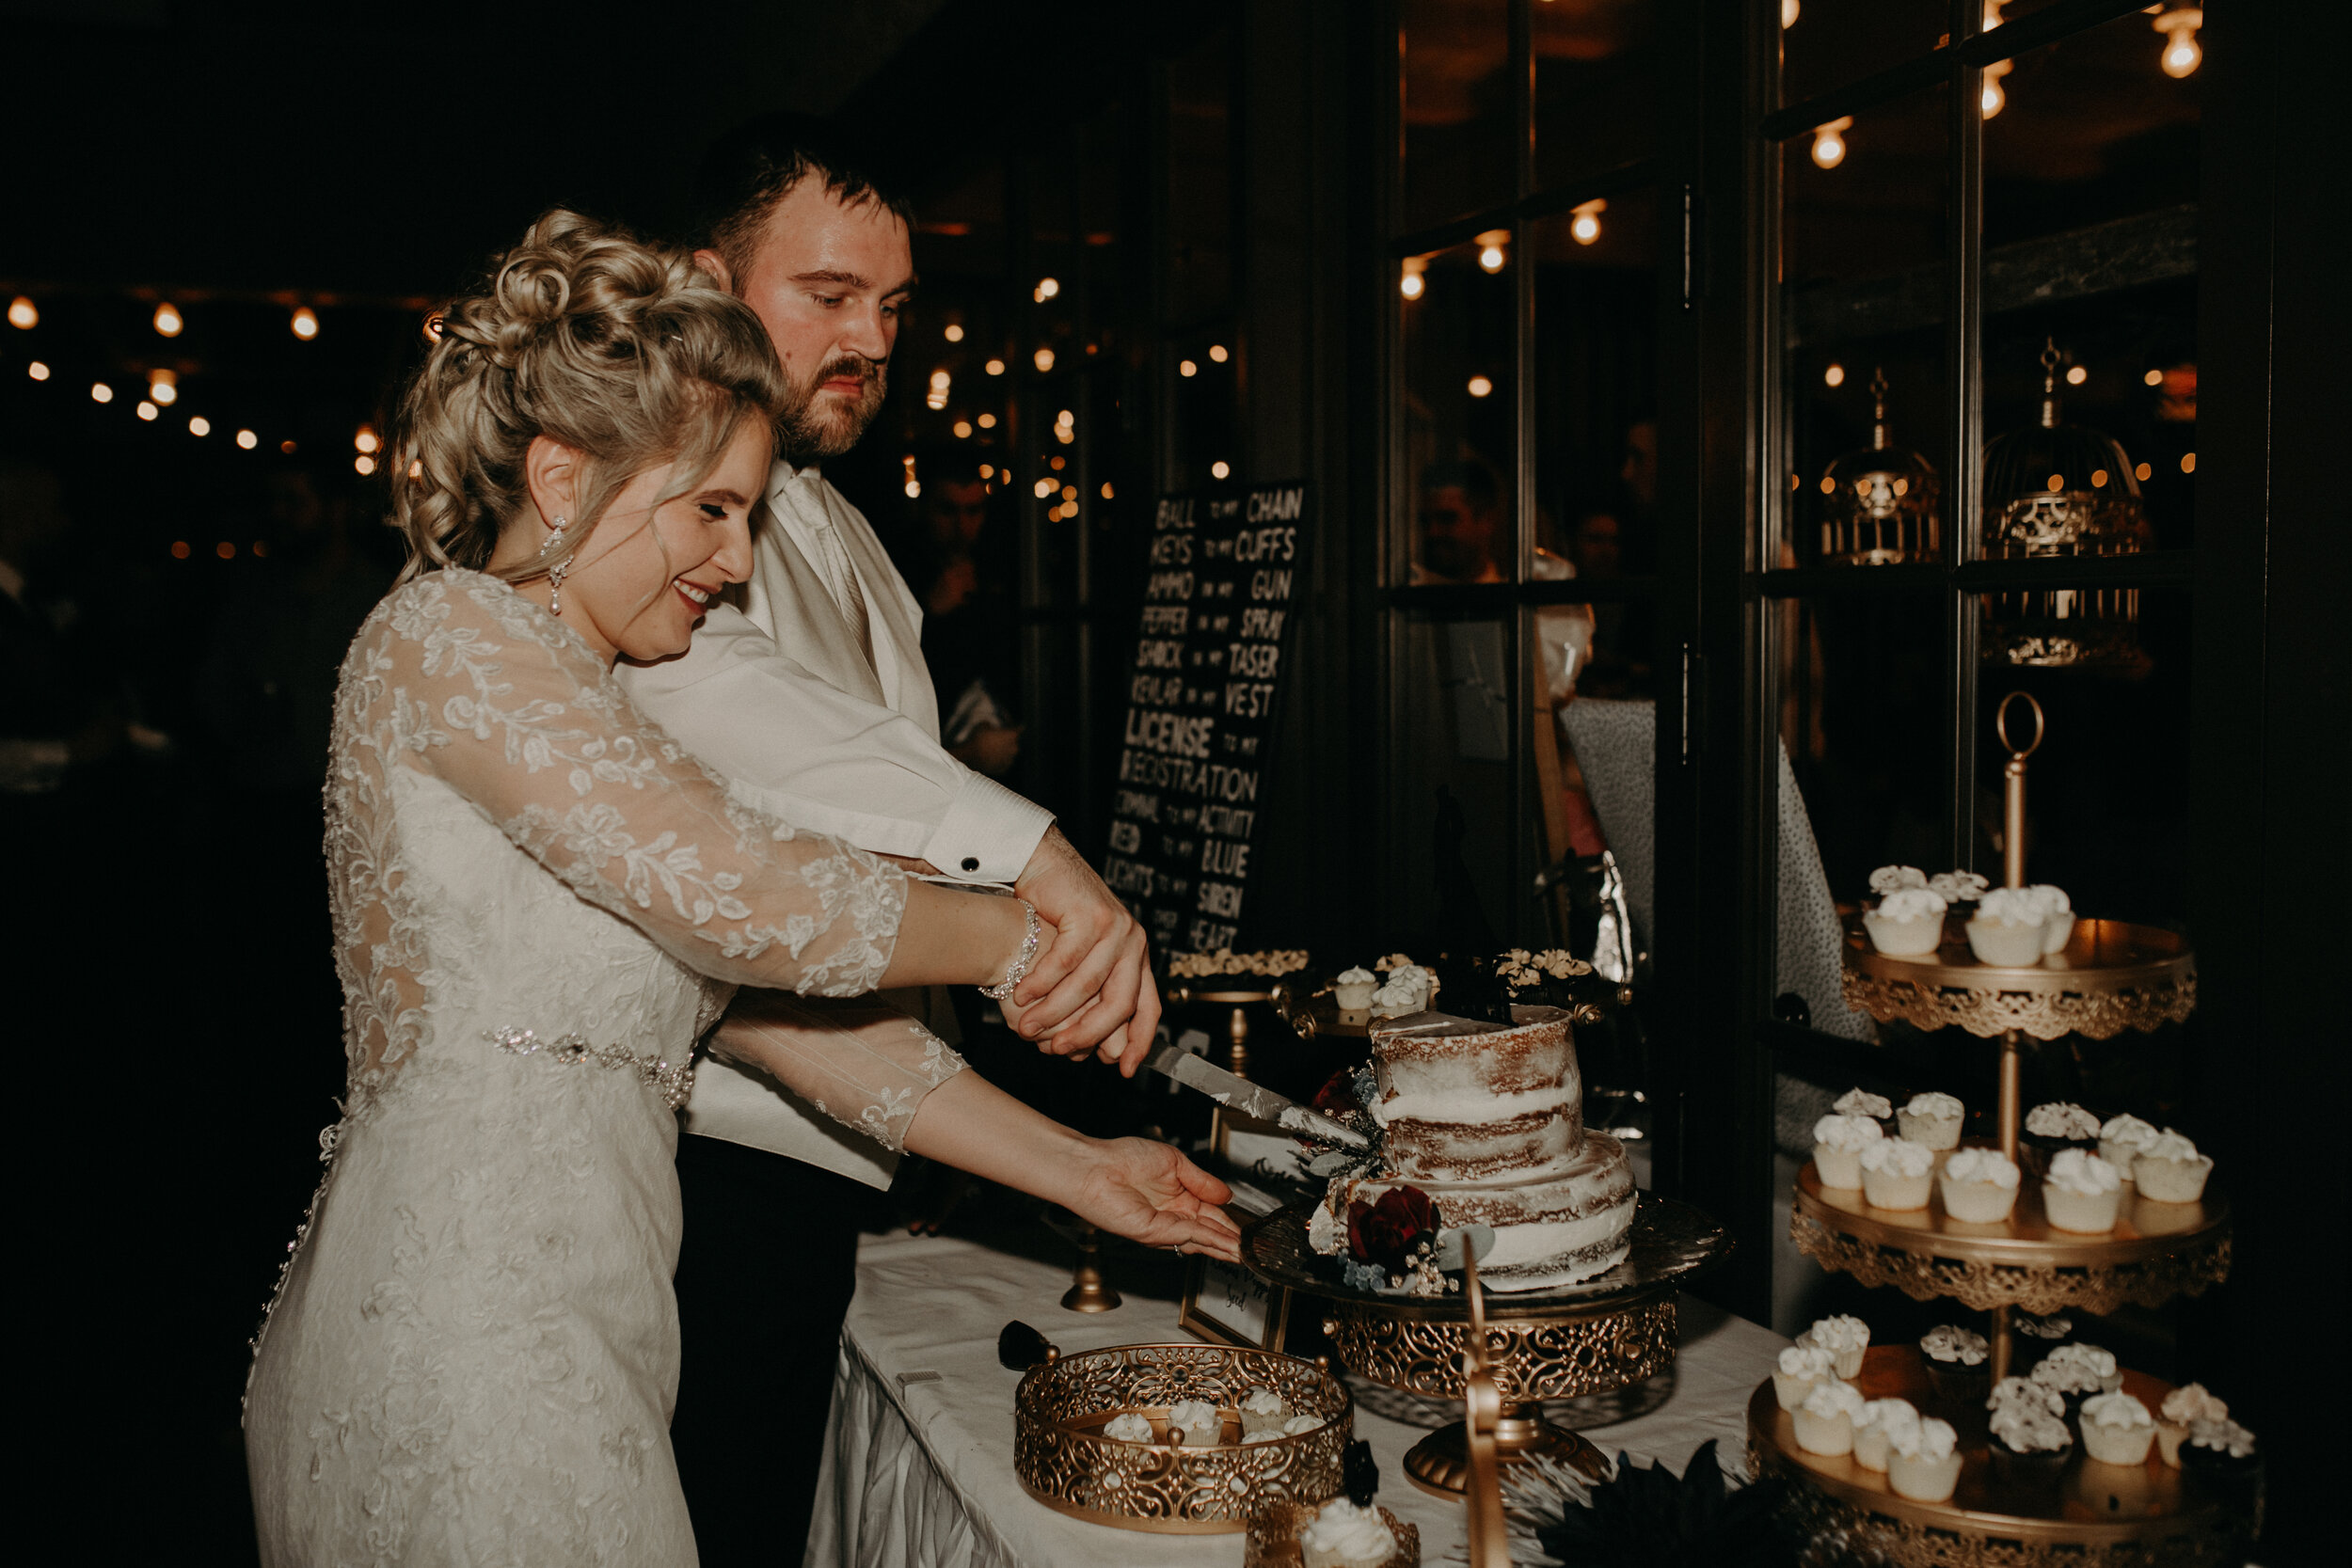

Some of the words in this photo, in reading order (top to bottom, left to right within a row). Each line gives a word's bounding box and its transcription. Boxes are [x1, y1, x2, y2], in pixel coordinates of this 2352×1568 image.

[1247, 487, 1304, 523] CHAIN
[1149, 533, 1196, 565] KEYS
[1234, 527, 1297, 562] CUFFS
[1250, 568, 1294, 601] GUN
[1239, 607, 1287, 642] SPRAY
[1229, 641, 1279, 679] TASER
[1225, 682, 1275, 719] VEST
[1123, 707, 1216, 759] LICENSE
[1118, 748, 1260, 802] REGISTRATION
[1200, 838, 1251, 879] BLUE
